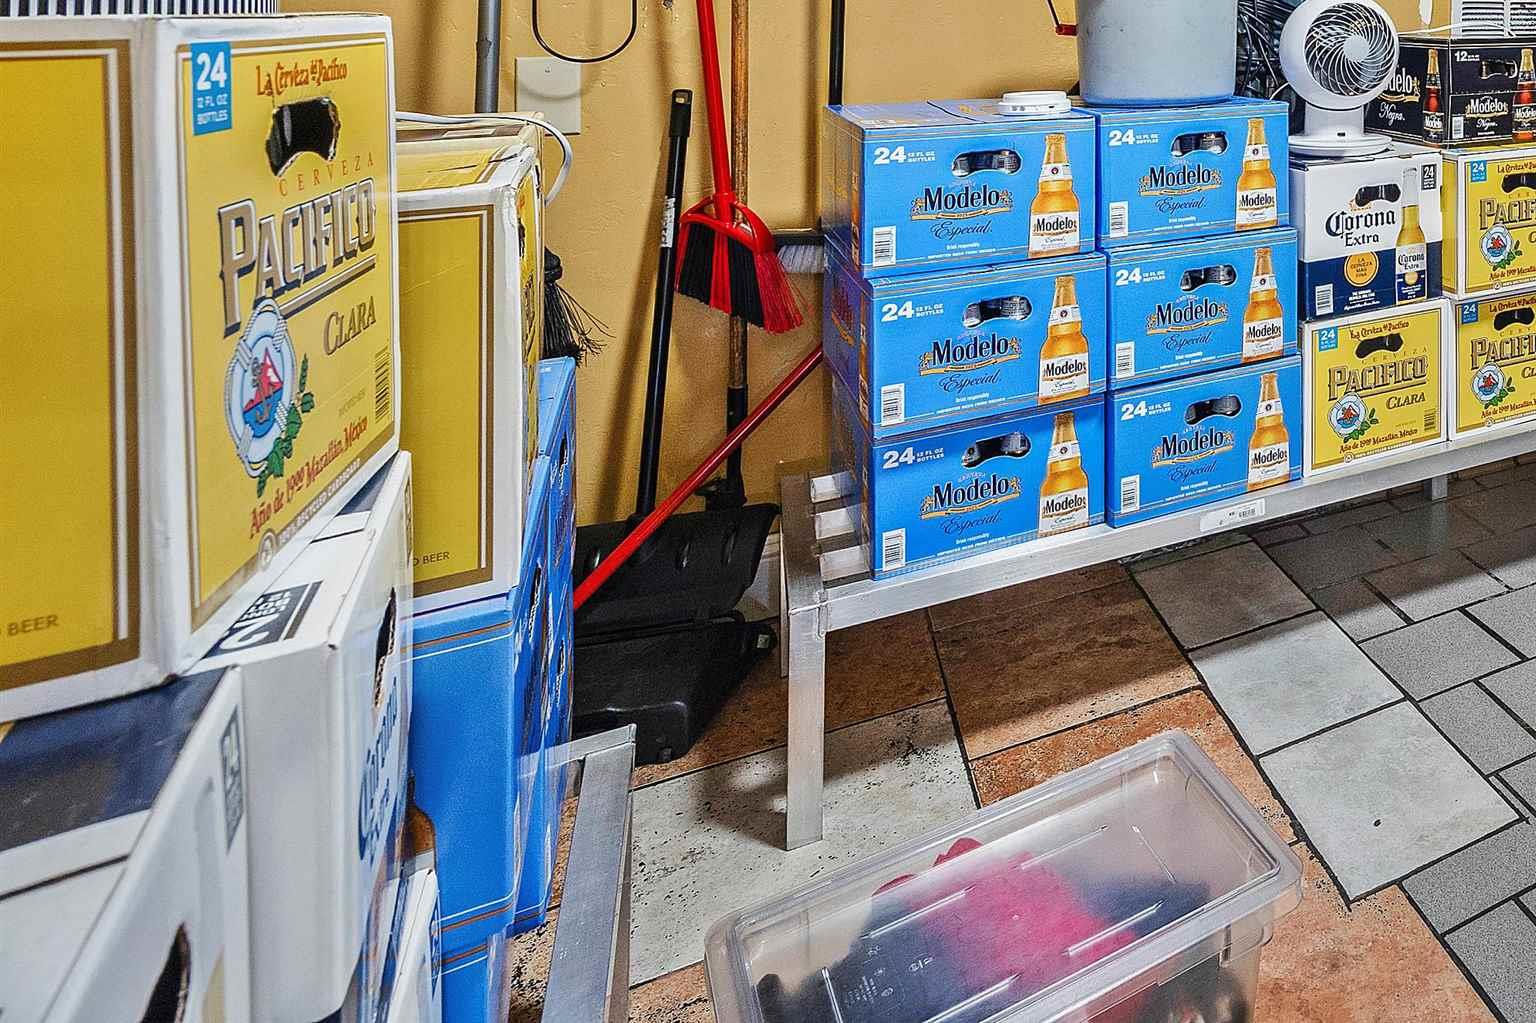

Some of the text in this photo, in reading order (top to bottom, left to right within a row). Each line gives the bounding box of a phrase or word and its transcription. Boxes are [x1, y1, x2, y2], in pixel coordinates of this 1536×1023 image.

[1455, 51, 1467, 62] 12
[197, 52, 228, 91] 24
[275, 61, 309, 95] Cerveza
[1389, 67, 1412, 93] delo
[1470, 98, 1504, 114] Modelo
[1108, 129, 1135, 146] 24
[873, 146, 907, 165] 24
[278, 153, 376, 198] CERVEZA
[1150, 164, 1211, 188] Modelo
[1424, 166, 1434, 178] 24
[1473, 162, 1484, 172] 24
[924, 184, 1000, 212] Modelo
[1155, 197, 1204, 215] Especial
[1241, 193, 1272, 207] Modelo
[930, 220, 989, 241] Especial
[1036, 216, 1074, 232] Modelo
[1325, 209, 1396, 239] Corona
[1345, 231, 1380, 247] Extra
[217, 178, 377, 339] PACIFICO
[1398, 252, 1425, 266] Corona
[1116, 268, 1142, 286] 24
[881, 301, 914, 322] 24
[1156, 297, 1219, 326] Modelo
[1463, 304, 1476, 314] 24
[323, 296, 376, 357] CLARA
[1248, 324, 1279, 338] Modelo
[1321, 329, 1335, 341] 24
[932, 334, 1009, 365] Modelo
[1161, 331, 1210, 352] Especial
[1045, 359, 1082, 376] Modelo
[939, 370, 1000, 394] Especial
[1328, 356, 1428, 401] PACIFICO
[1121, 400, 1147, 421] 24
[1386, 392, 1426, 409] CLARA
[1162, 426, 1224, 459] Modelo
[882, 447, 915, 469] 24
[1254, 452, 1284, 465] Modelo
[1168, 460, 1216, 481] Especial
[933, 474, 1009, 510] Modelo
[1045, 494, 1082, 513] Modelo
[939, 510, 1000, 535] Especial
[423, 551, 450, 564] BEER
[7, 614, 58, 636] BEER
